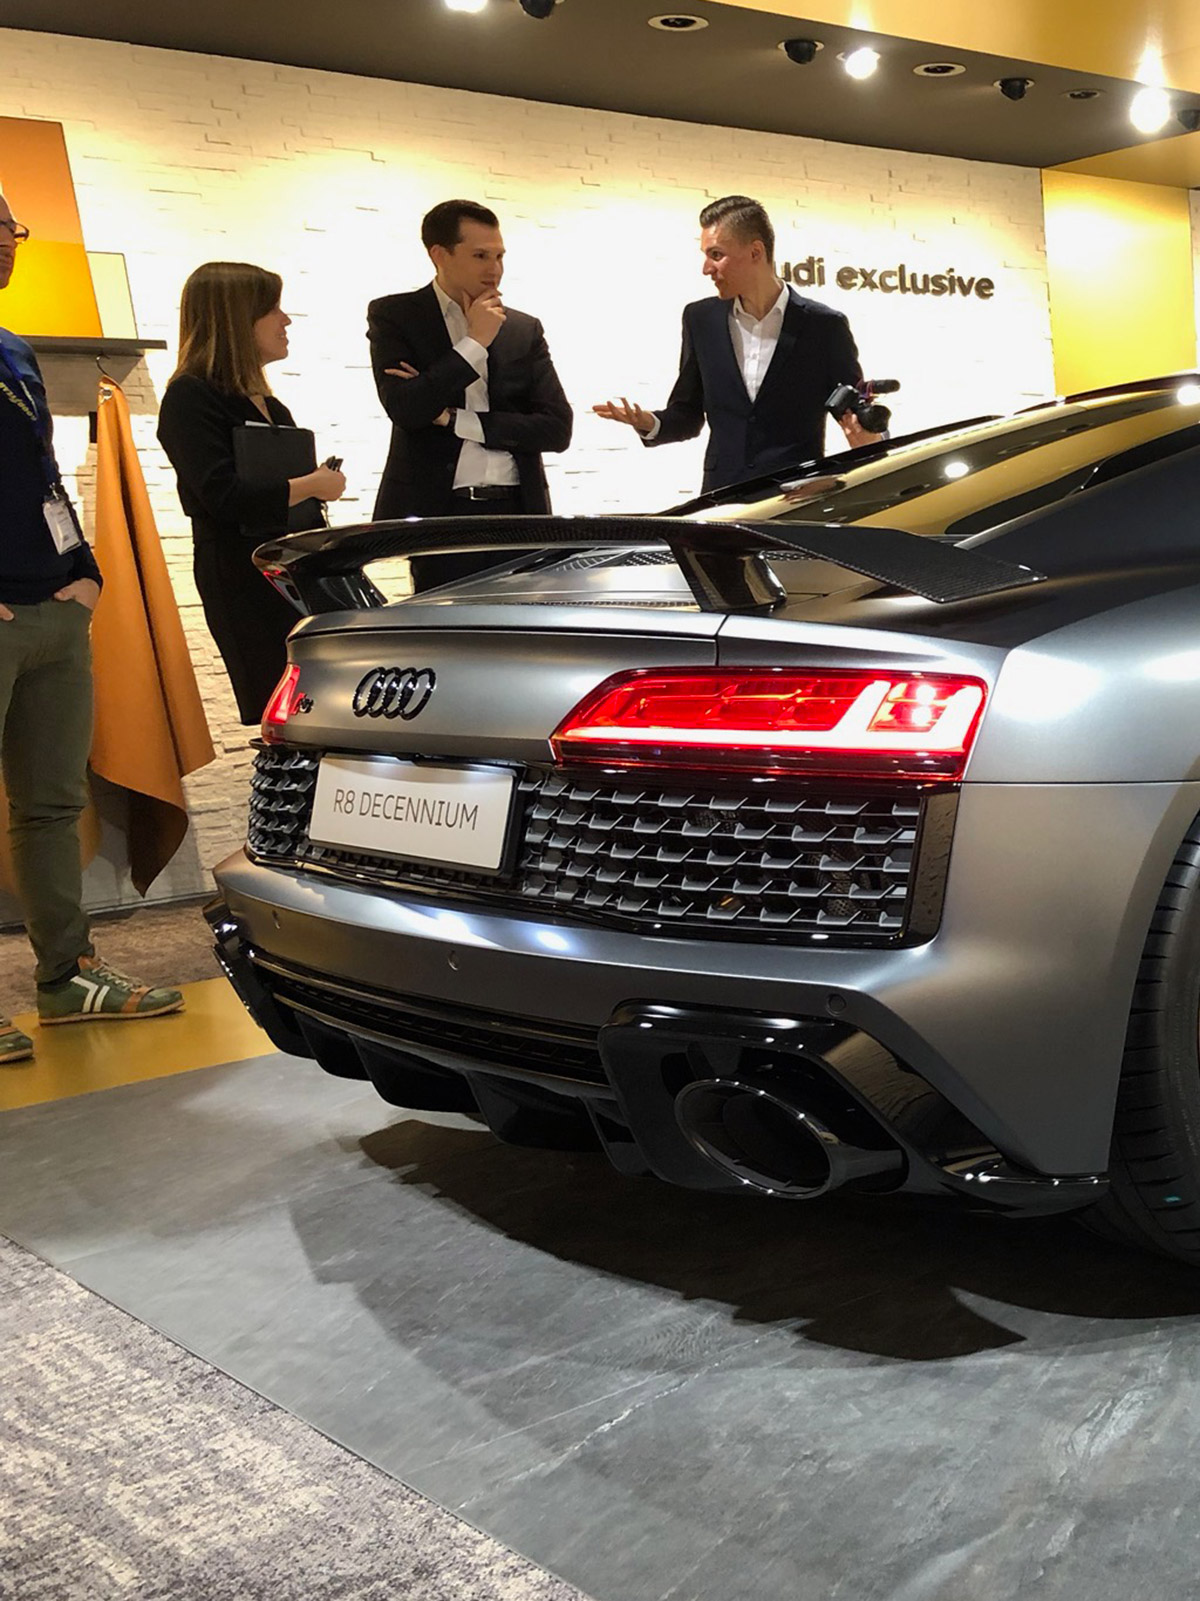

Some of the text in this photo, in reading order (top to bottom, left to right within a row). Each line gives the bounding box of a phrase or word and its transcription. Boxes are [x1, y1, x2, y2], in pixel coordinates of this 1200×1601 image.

[774, 256, 995, 299] udi exclusive
[333, 788, 479, 830] R8 DECENNIUM
